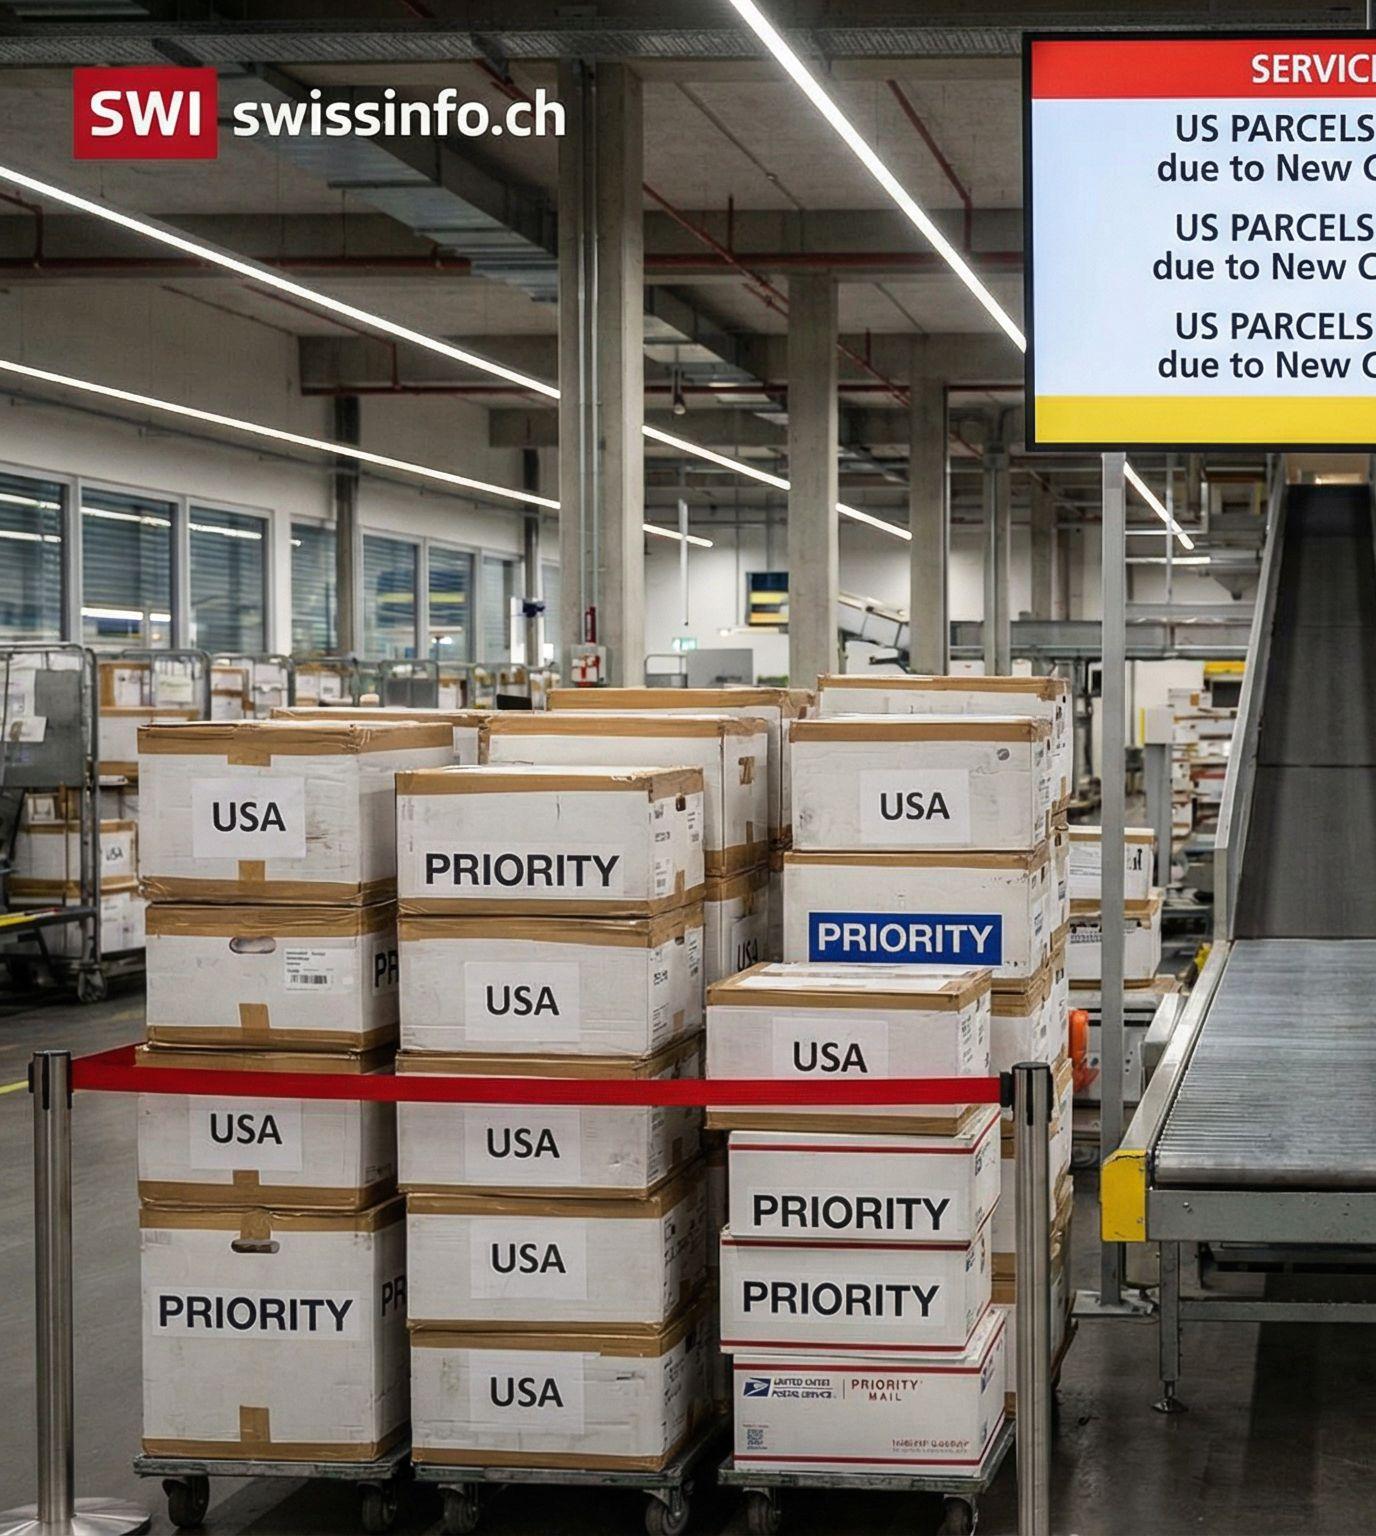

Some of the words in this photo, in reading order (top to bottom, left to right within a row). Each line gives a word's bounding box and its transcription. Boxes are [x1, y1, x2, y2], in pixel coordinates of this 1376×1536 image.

[1176, 114, 1219, 143] US
[1231, 113, 1375, 143] PARCELS
[1157, 152, 1219, 182] due
[1229, 155, 1265, 182] to
[1277, 153, 1353, 182] New
[1176, 213, 1219, 242] US
[1231, 213, 1374, 242] PARCELS
[1152, 250, 1215, 280] due
[1224, 254, 1260, 280] to
[1272, 252, 1347, 280] New
[1176, 311, 1219, 340] US
[1231, 312, 1374, 340] PARCELS
[1158, 349, 1219, 379] due
[1229, 352, 1264, 379] to
[1276, 351, 1352, 379] New
[212, 801, 287, 833] USA
[880, 791, 951, 821] USA
[425, 853, 620, 887] PRIORITY
[818, 922, 994, 954] PRIORITY
[486, 985, 560, 1016] USA
[793, 1041, 868, 1074] USA
[210, 1113, 283, 1145] USA
[486, 1127, 560, 1159] USA
[753, 1194, 951, 1231] PRIORITY
[491, 1243, 567, 1274] USA
[159, 1295, 354, 1332] PRIORITY
[743, 1280, 940, 1317] PRIORITY
[490, 1376, 564, 1408] USA
[851, 1378, 918, 1391] PRIORITY
[868, 1391, 902, 1402] MAIL
